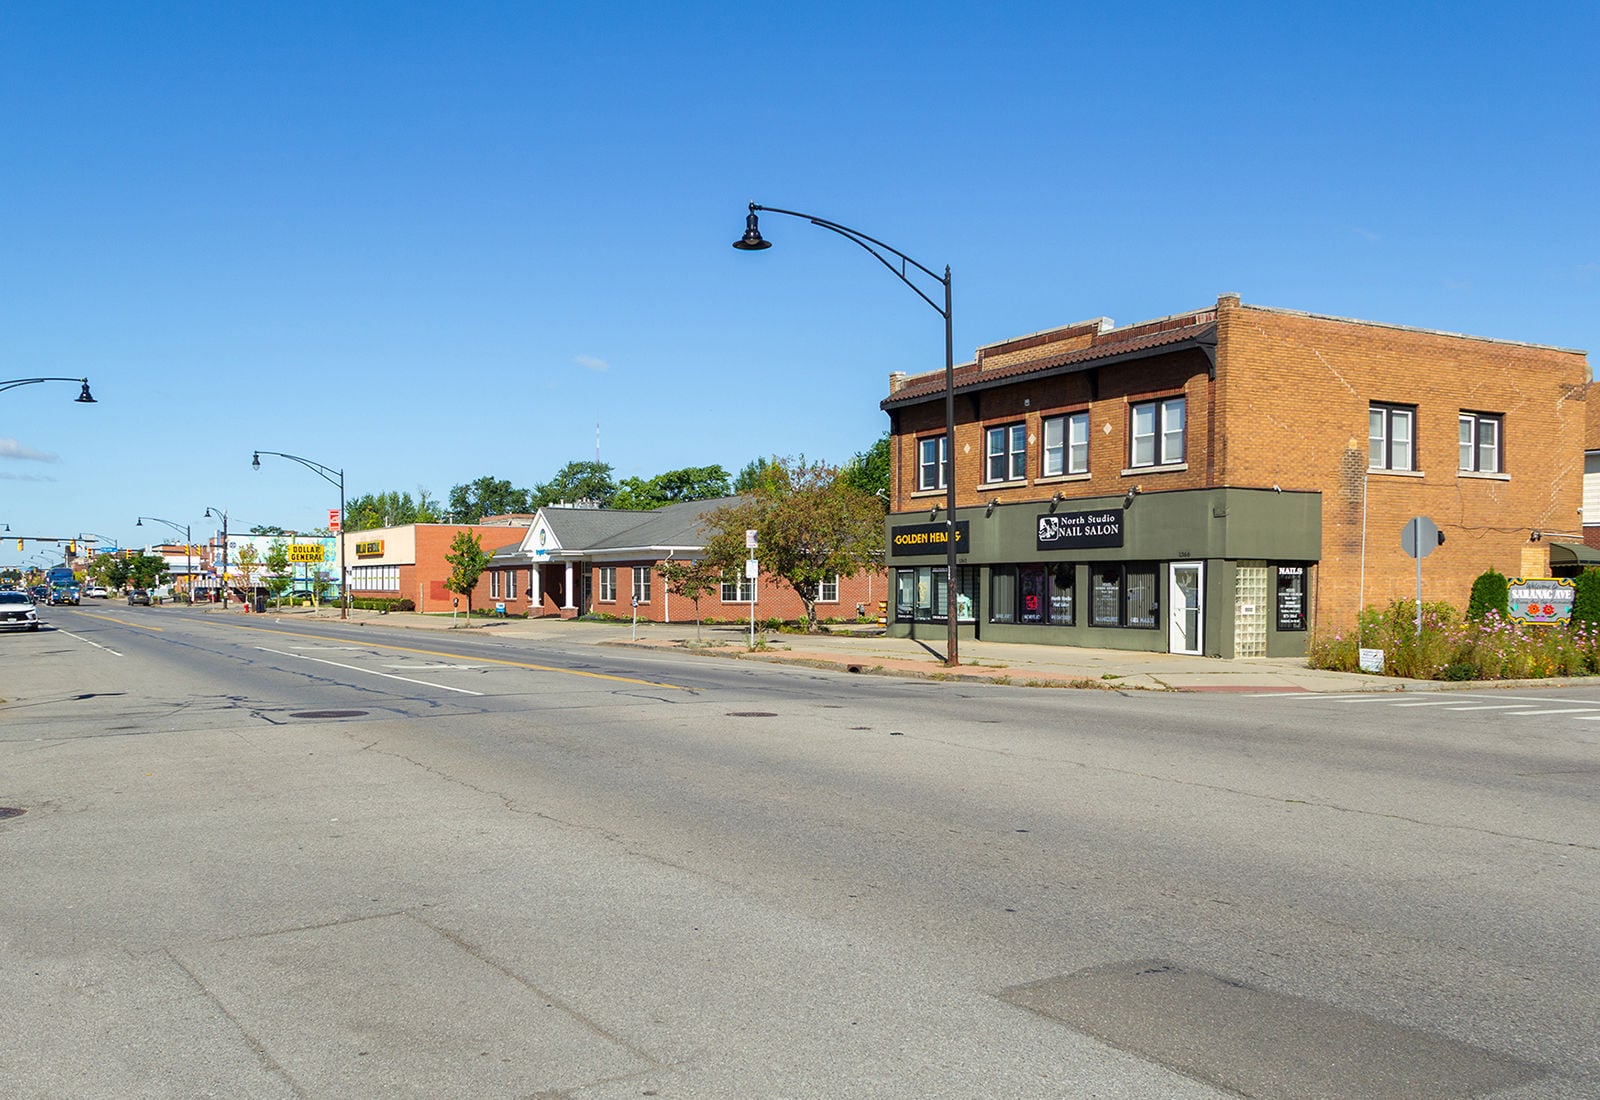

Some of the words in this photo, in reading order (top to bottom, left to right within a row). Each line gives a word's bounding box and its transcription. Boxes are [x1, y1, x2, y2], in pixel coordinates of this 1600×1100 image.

[1061, 516, 1085, 525] North
[1087, 514, 1115, 524] Studio
[1058, 526, 1083, 537] NAIL
[1084, 524, 1119, 536] SALON
[895, 533, 928, 545] GOLDEN
[291, 553, 322, 561] GENERAL
[1278, 567, 1303, 575] NAILS
[1511, 589, 1553, 599] SARANAC
[1554, 589, 1572, 599] AVE
